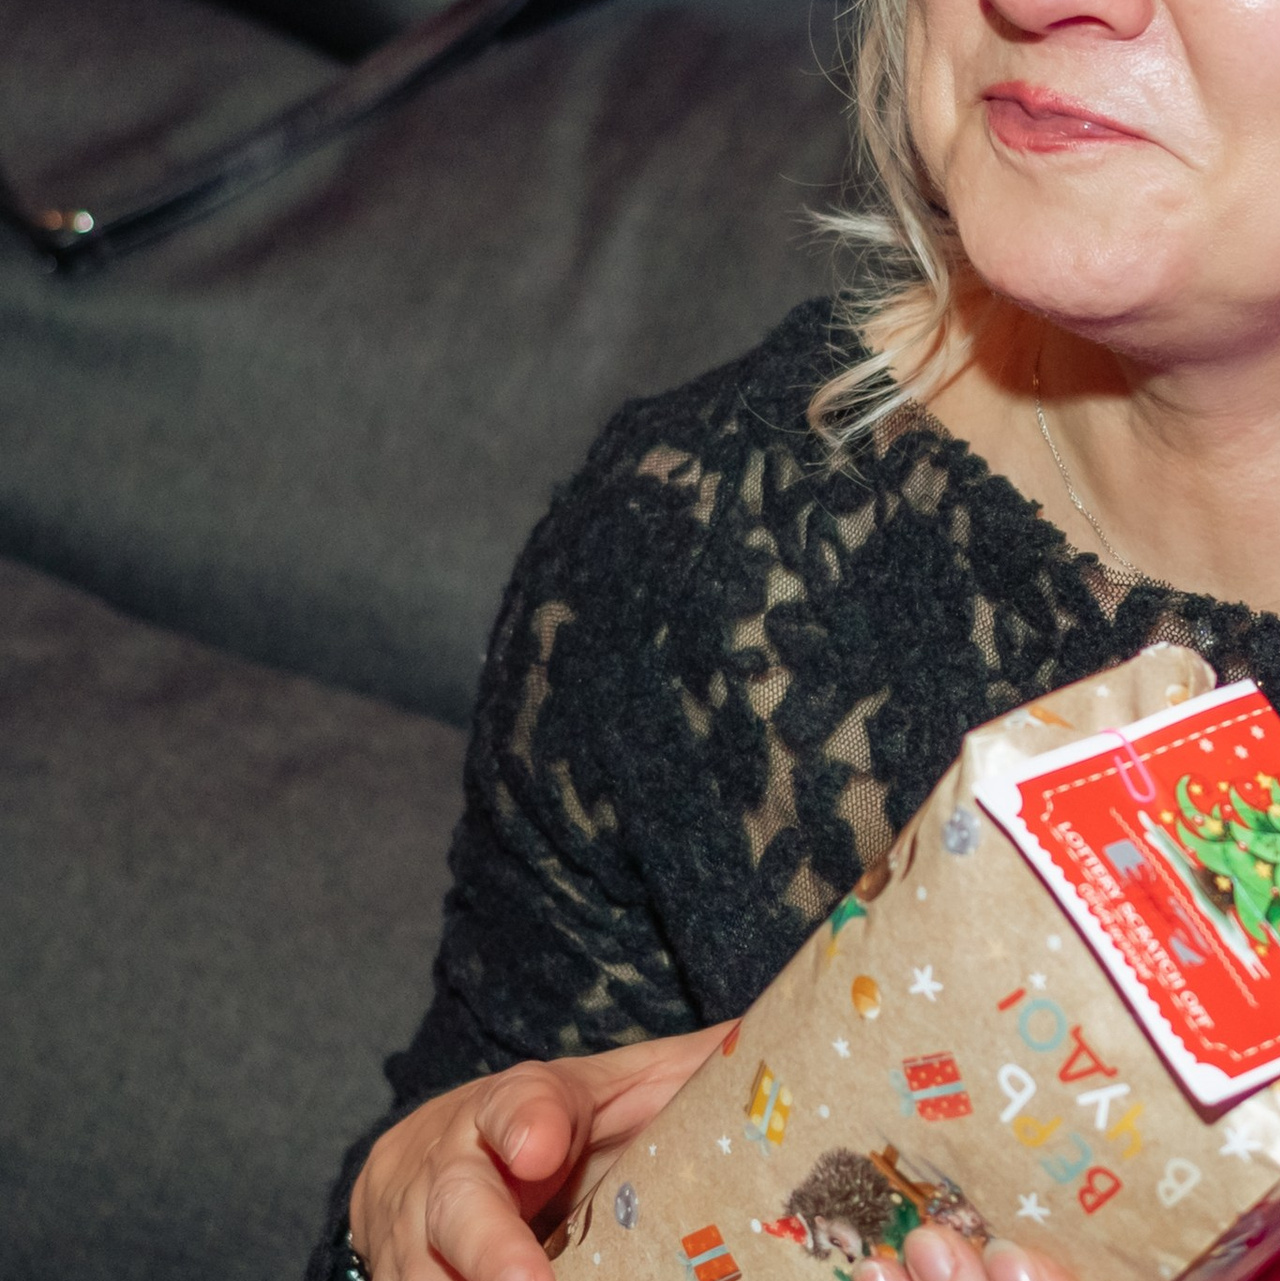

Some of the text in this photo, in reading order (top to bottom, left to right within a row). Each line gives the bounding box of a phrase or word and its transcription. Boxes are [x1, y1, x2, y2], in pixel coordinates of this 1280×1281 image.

[1119, 901, 1186, 991] SCRATCH
[998, 1063, 1121, 1215] ВЕРЬ
[1157, 1157, 1202, 1208] В
